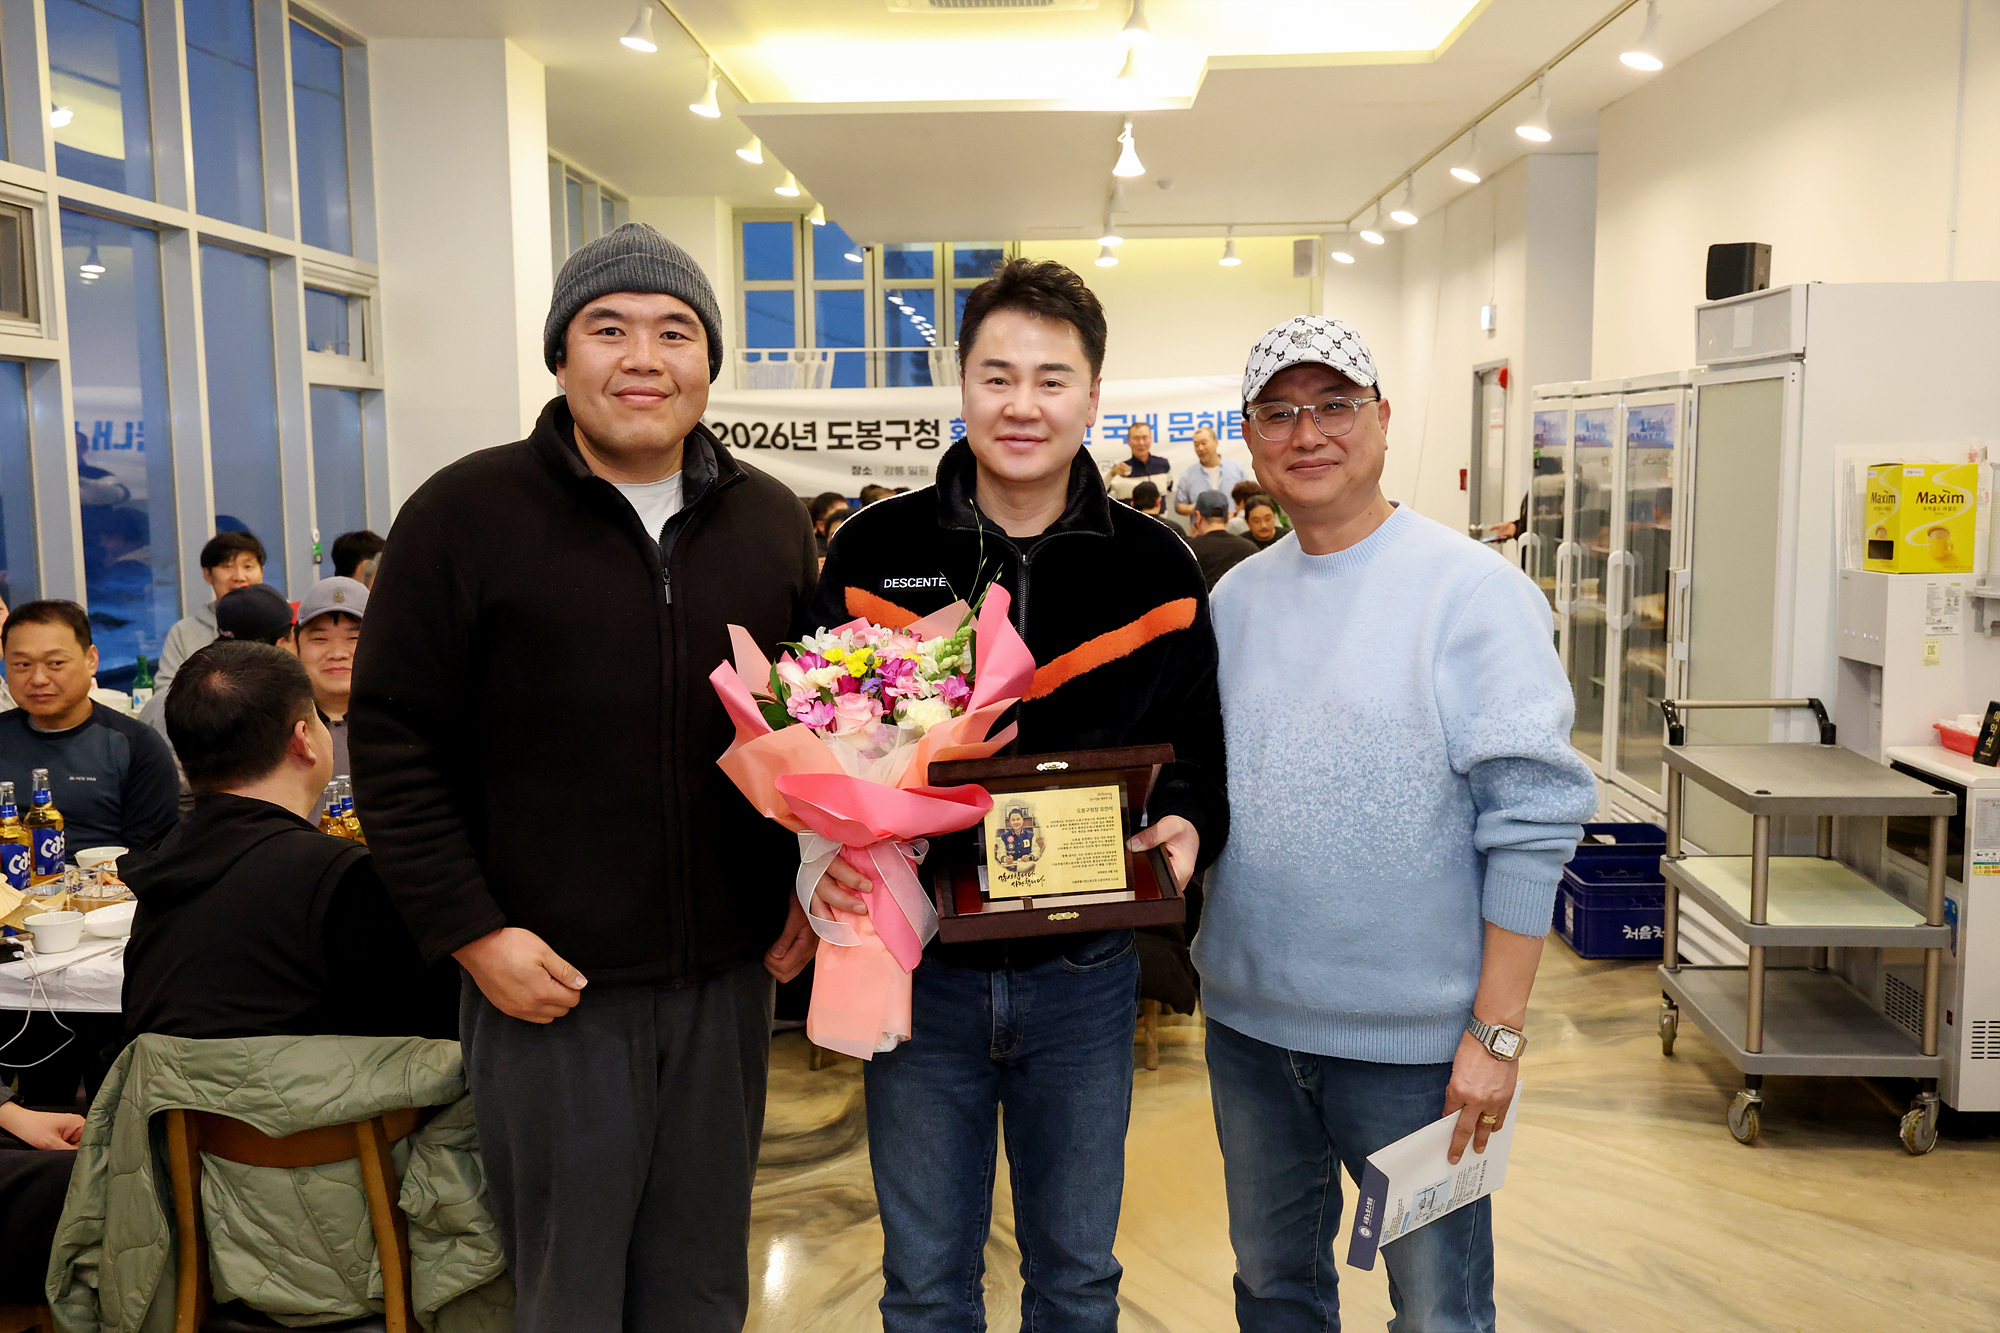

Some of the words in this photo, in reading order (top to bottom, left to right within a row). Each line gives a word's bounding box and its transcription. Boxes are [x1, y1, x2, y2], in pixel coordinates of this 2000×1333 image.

[711, 421, 818, 451] 2026년
[827, 419, 940, 451] 도봉구청
[1870, 489, 1896, 504] Maxim
[1915, 489, 1965, 504] Maxim
[883, 577, 947, 588] DESCENTE
